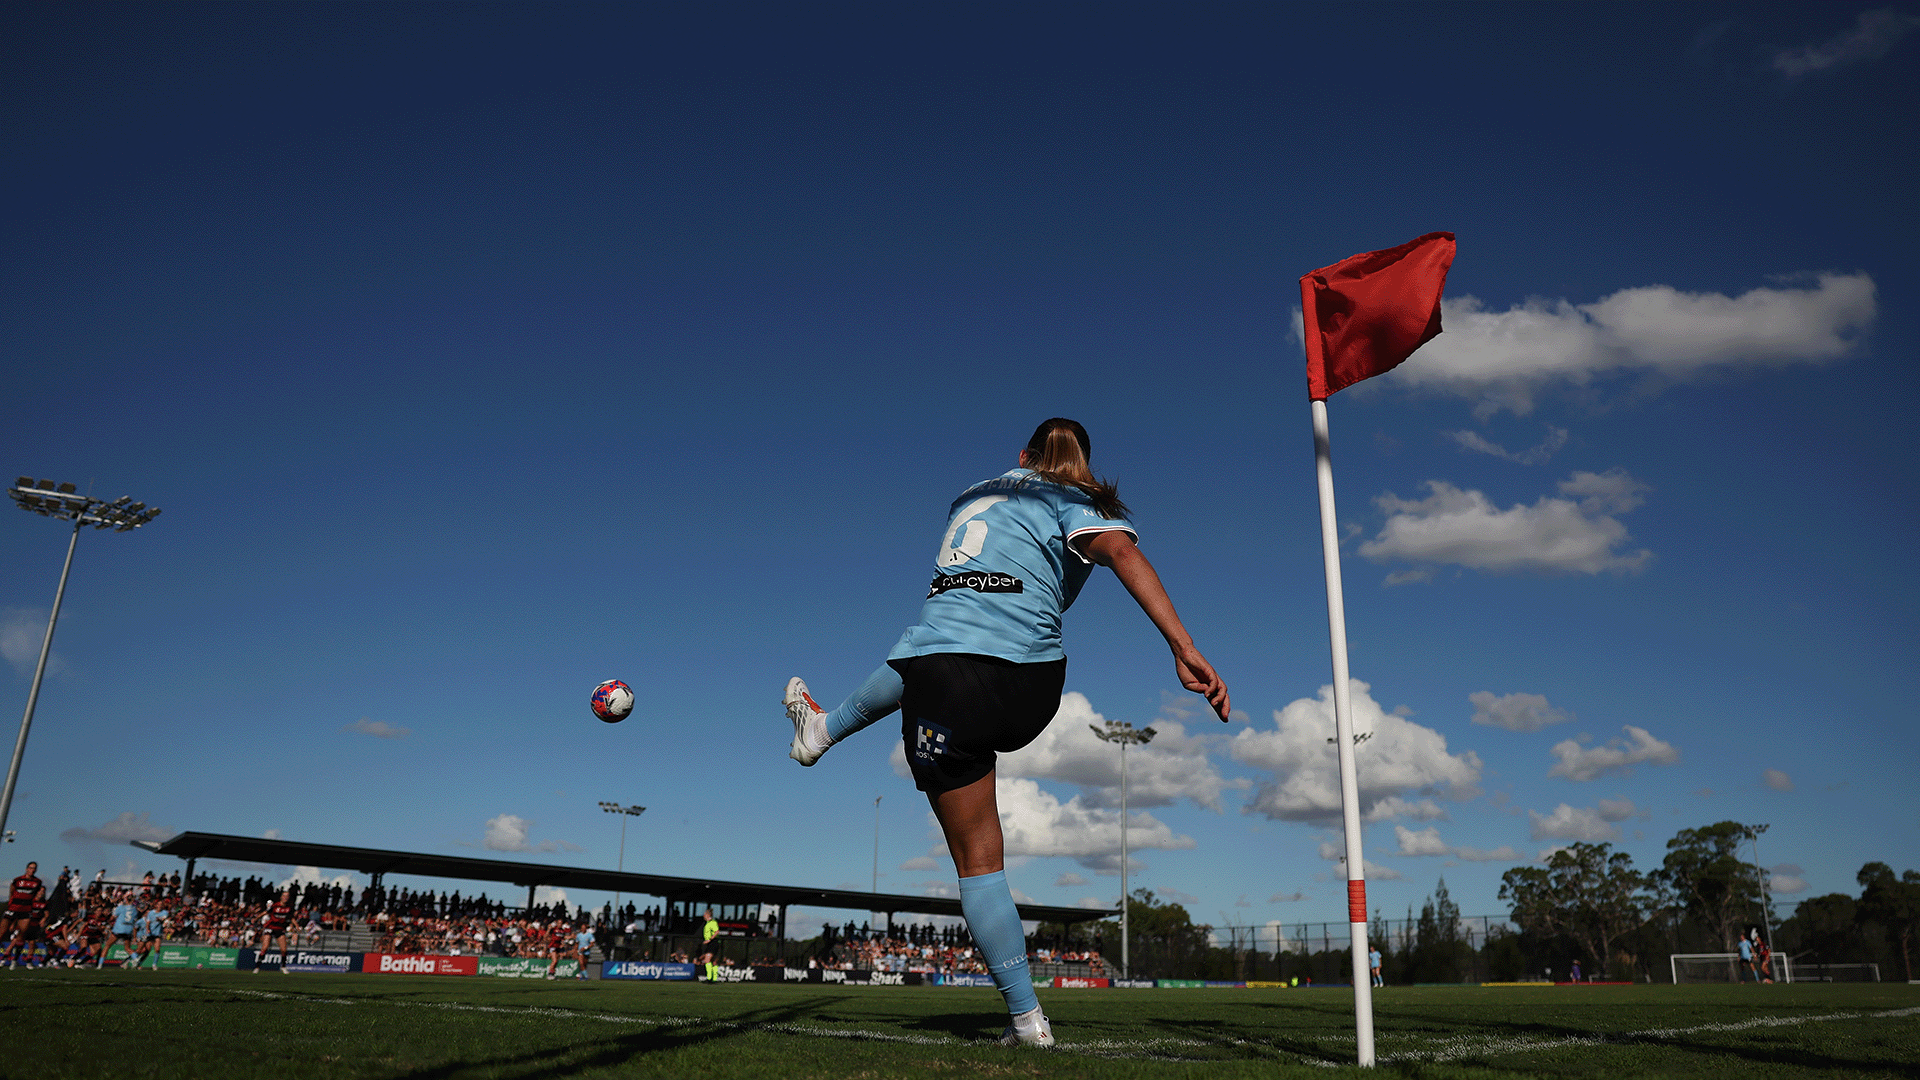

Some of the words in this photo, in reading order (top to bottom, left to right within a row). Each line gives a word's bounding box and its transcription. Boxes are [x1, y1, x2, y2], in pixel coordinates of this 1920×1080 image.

[938, 495, 1009, 567] 6
[380, 955, 436, 972] Bathla
[1002, 953, 1025, 968] CITY
[621, 963, 663, 979] Liberty
[945, 974, 974, 987] Lberty
